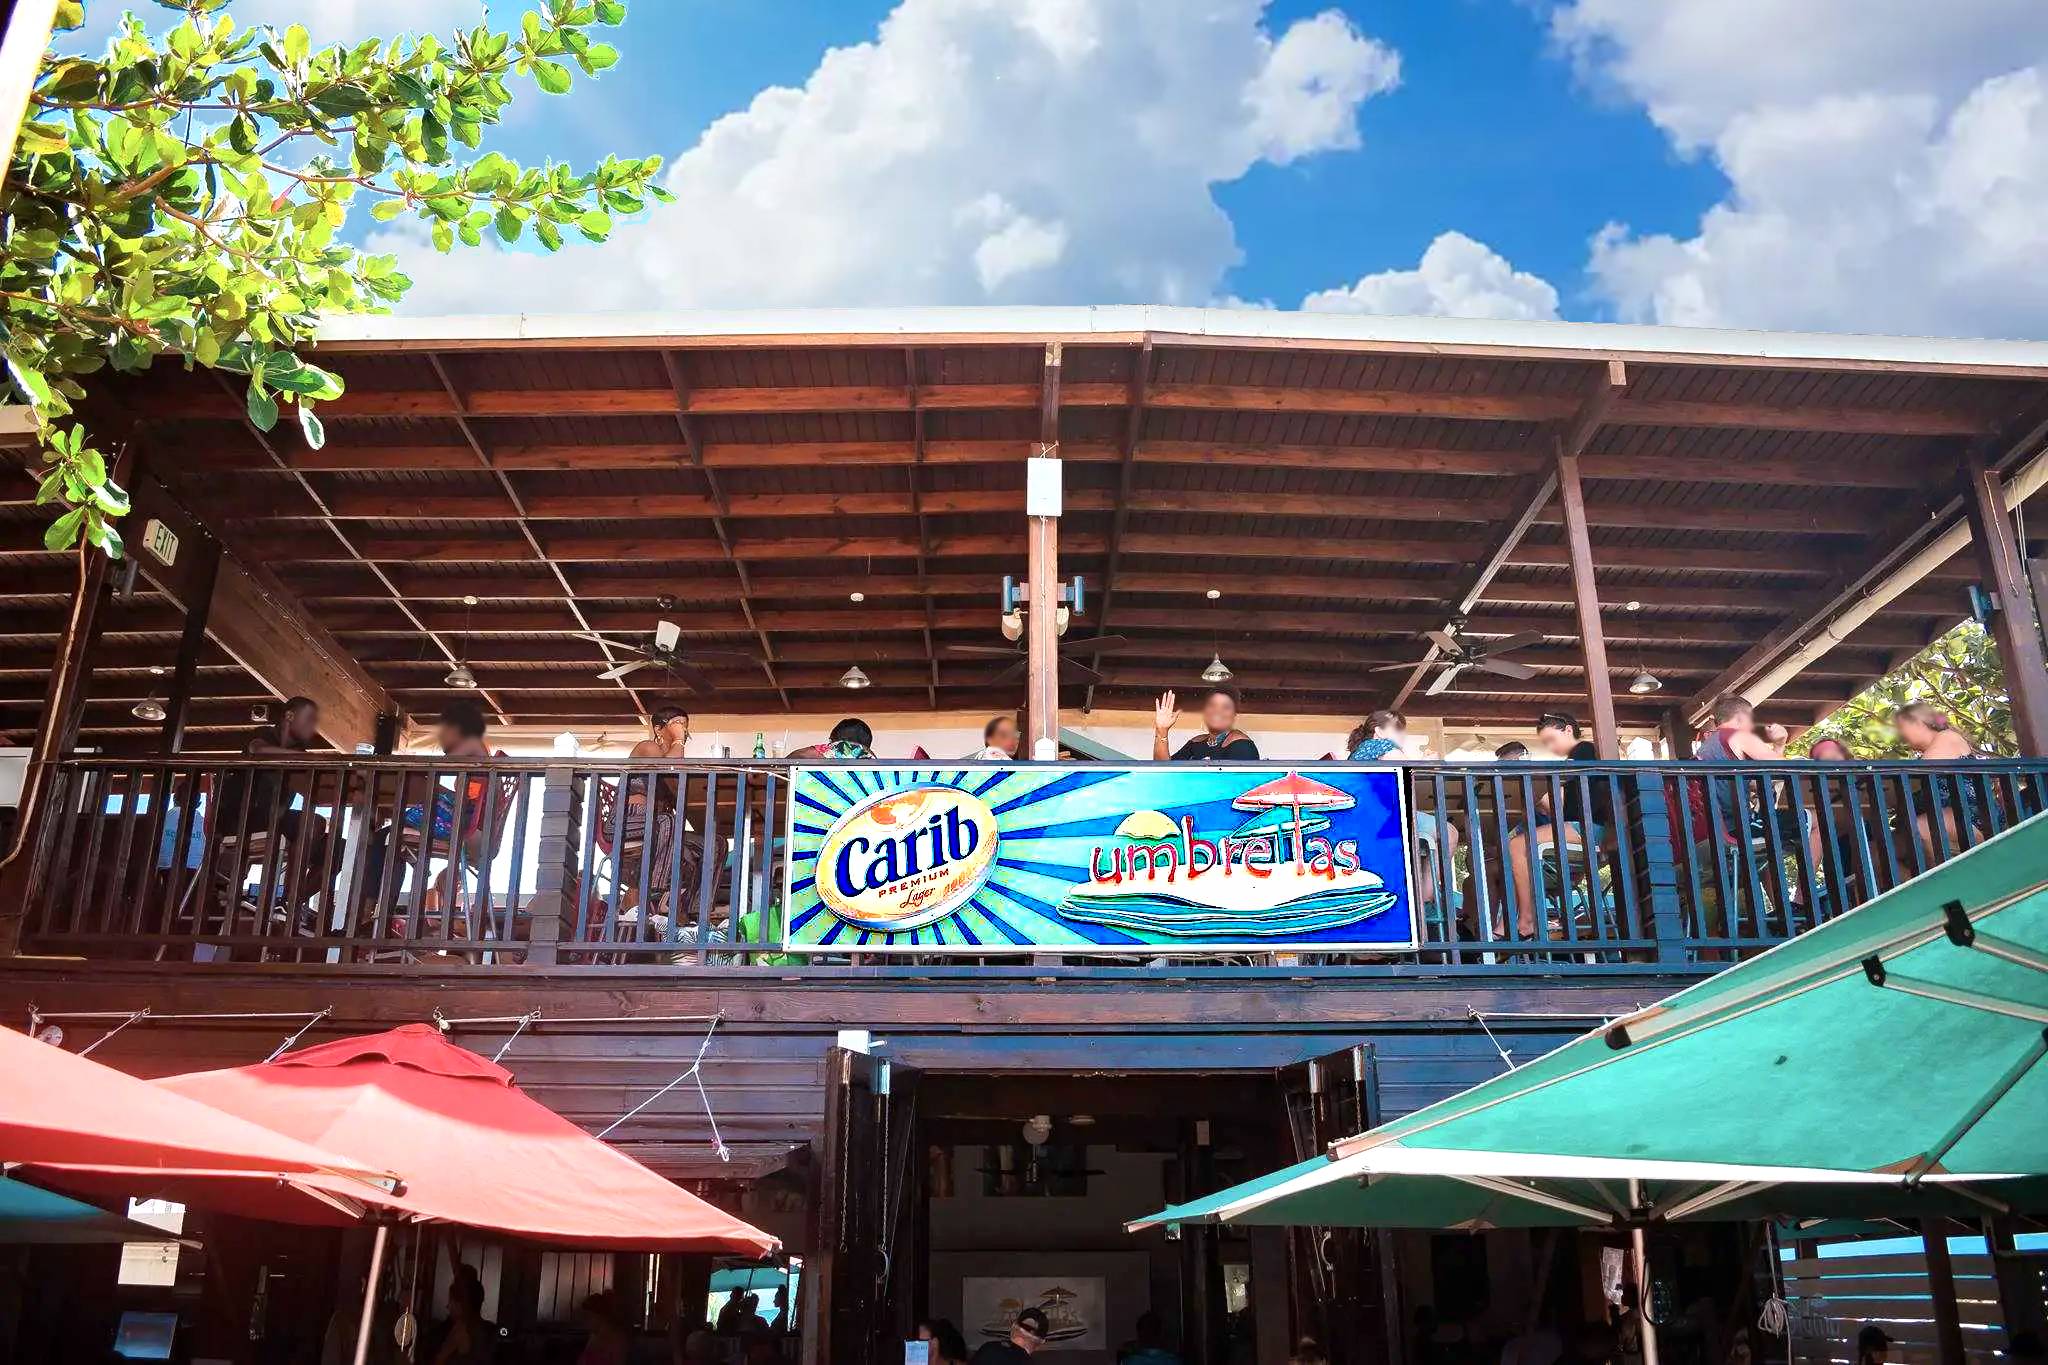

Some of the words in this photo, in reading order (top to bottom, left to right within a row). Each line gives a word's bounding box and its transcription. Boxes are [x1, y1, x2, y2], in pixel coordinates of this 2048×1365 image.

[154, 524, 177, 561] EXIT
[834, 804, 980, 899] Carib
[877, 867, 950, 899] PREMIUM
[899, 886, 936, 909] Lager
